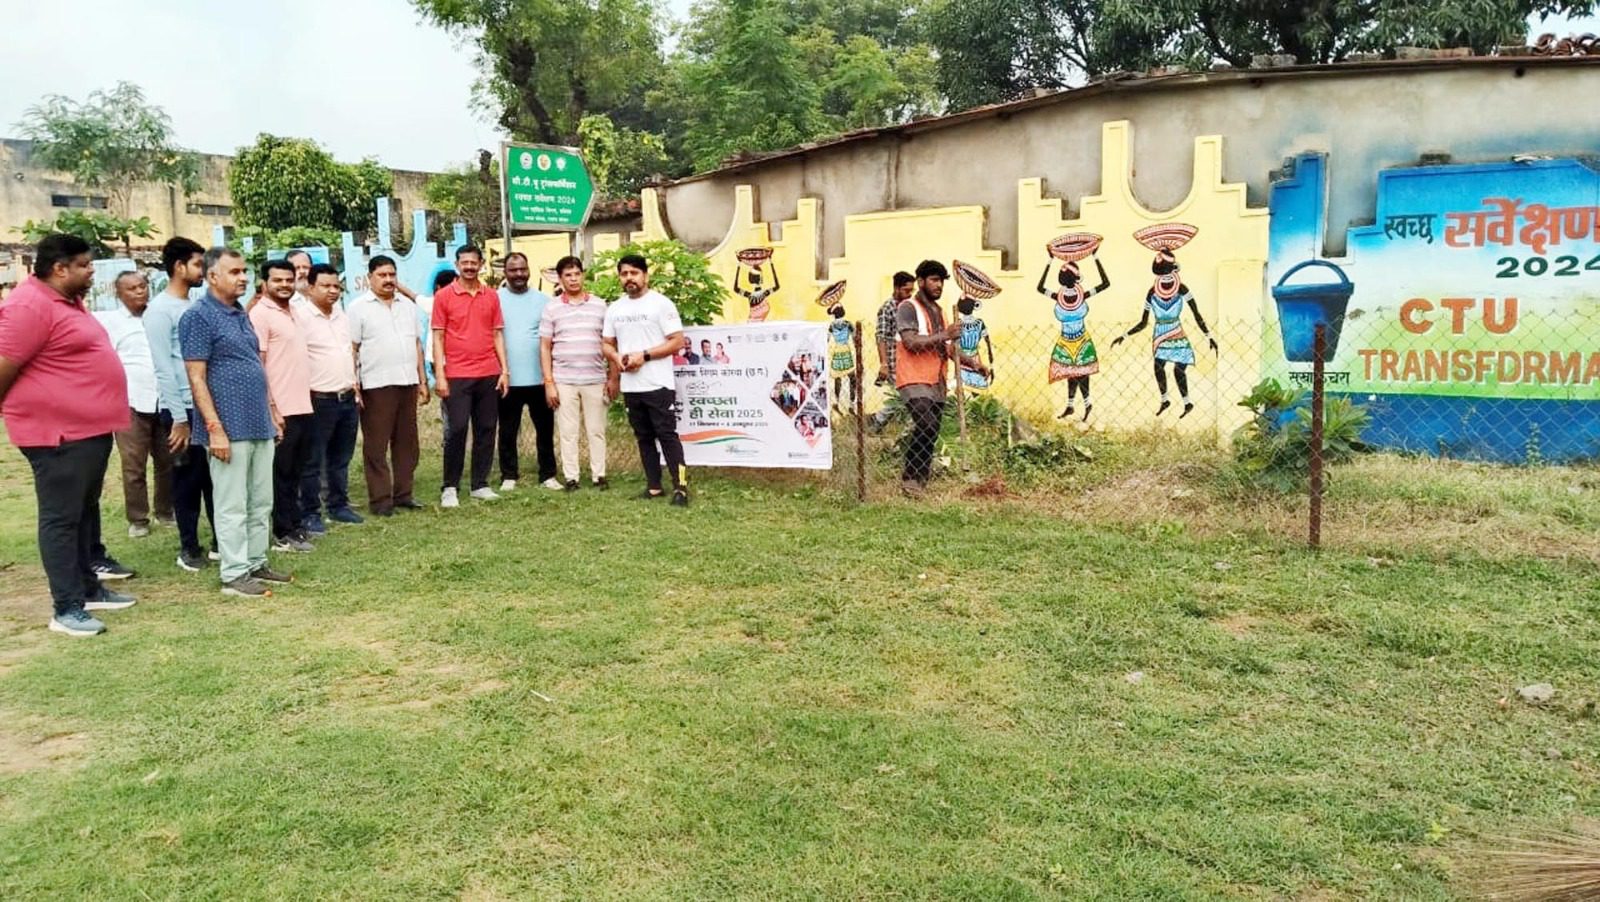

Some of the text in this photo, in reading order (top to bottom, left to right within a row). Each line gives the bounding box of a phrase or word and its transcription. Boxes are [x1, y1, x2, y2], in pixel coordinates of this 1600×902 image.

[557, 195, 576, 204] 2024
[1384, 213, 1437, 244] स्वच्छ
[688, 396, 737, 406] स्वच्छता
[689, 406, 704, 419] ही
[708, 407, 735, 419] सेवा
[736, 409, 764, 418] 2025
